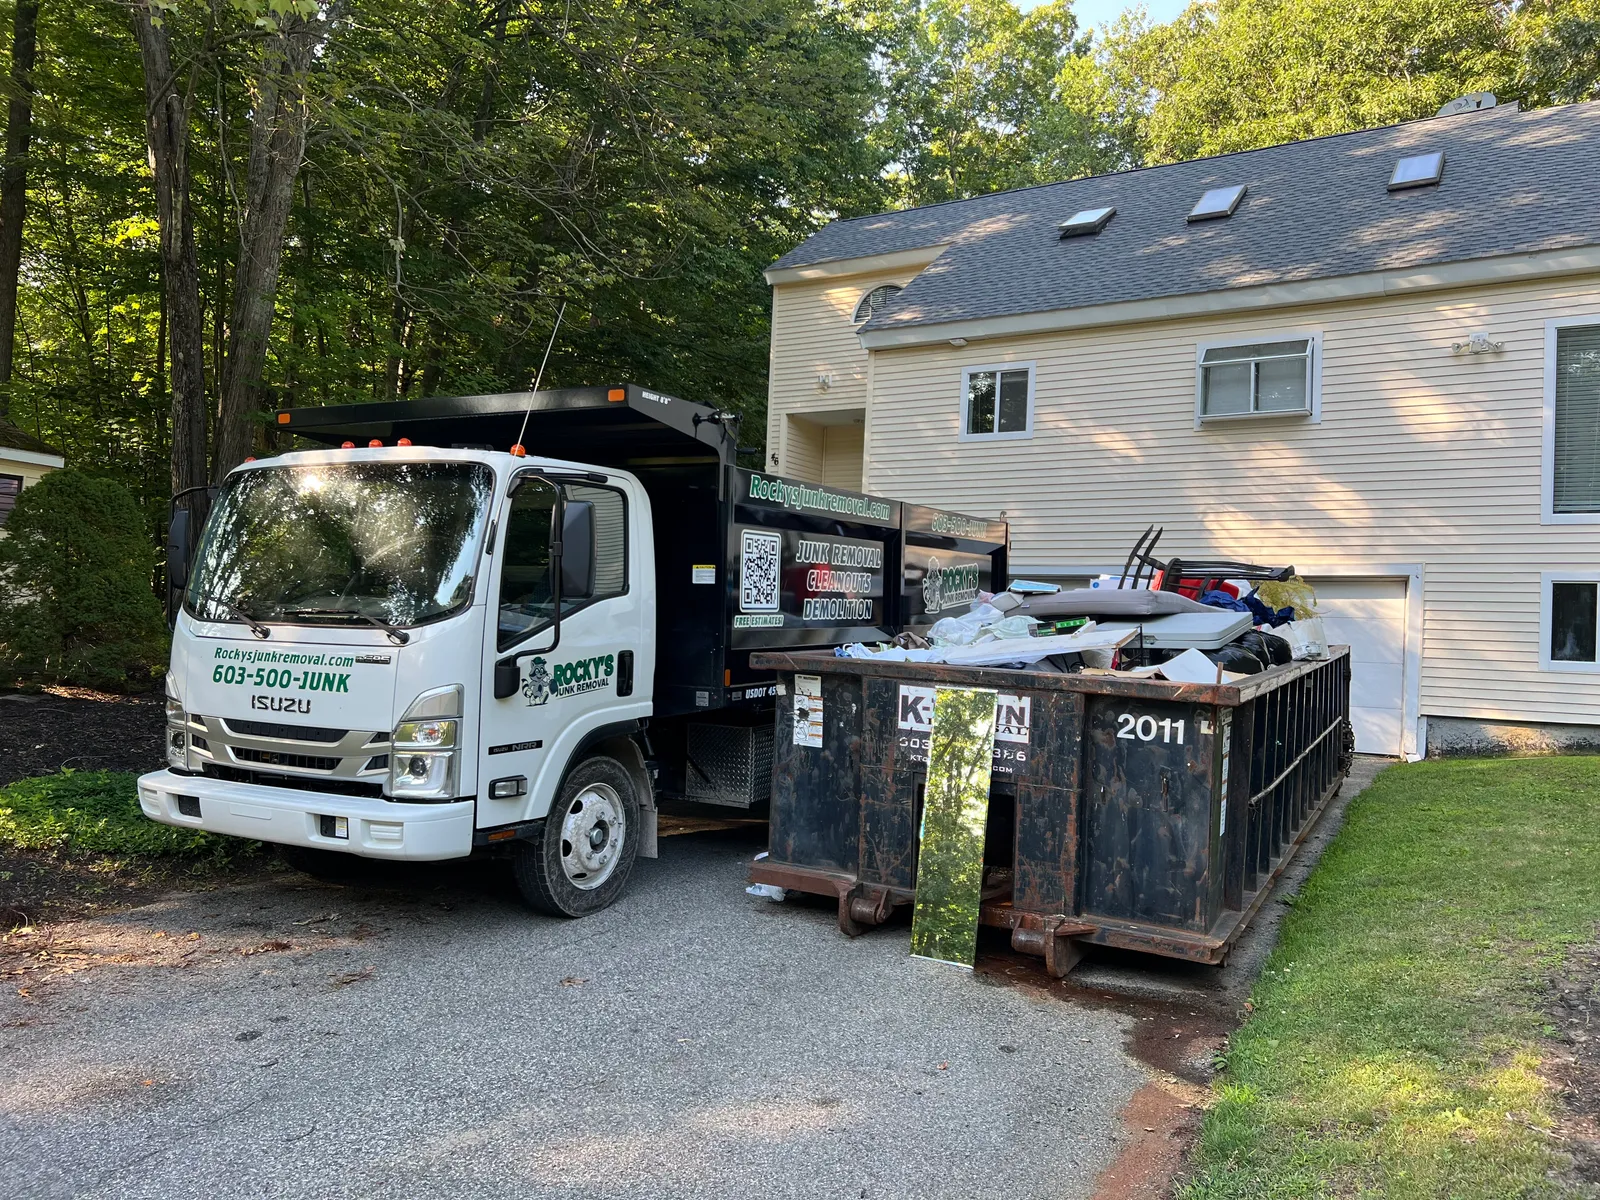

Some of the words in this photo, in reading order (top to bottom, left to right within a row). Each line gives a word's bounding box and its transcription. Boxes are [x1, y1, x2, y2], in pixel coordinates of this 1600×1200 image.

[642, 391, 659, 402] HEIGHT
[750, 474, 890, 520] Rockysjunkremoval.com
[796, 540, 830, 564] JUNK
[832, 544, 881, 568] REMOVAL
[807, 570, 871, 593] CLEANOUTS
[942, 564, 978, 593] ROCKY'S
[803, 599, 872, 620] DEMOLITION
[734, 615, 750, 627] FREE
[214, 647, 354, 667] Rockysjunkremoval.com
[212, 665, 352, 693] 603-500-JUNK
[554, 654, 614, 686] ROCKY'S
[556, 686, 575, 697] JUNK
[576, 678, 609, 693] REMOVAL
[745, 687, 767, 699] USDOT
[251, 694, 311, 714] ISUZU
[1116, 713, 1185, 745] 2011
[512, 742, 537, 751] NRR
